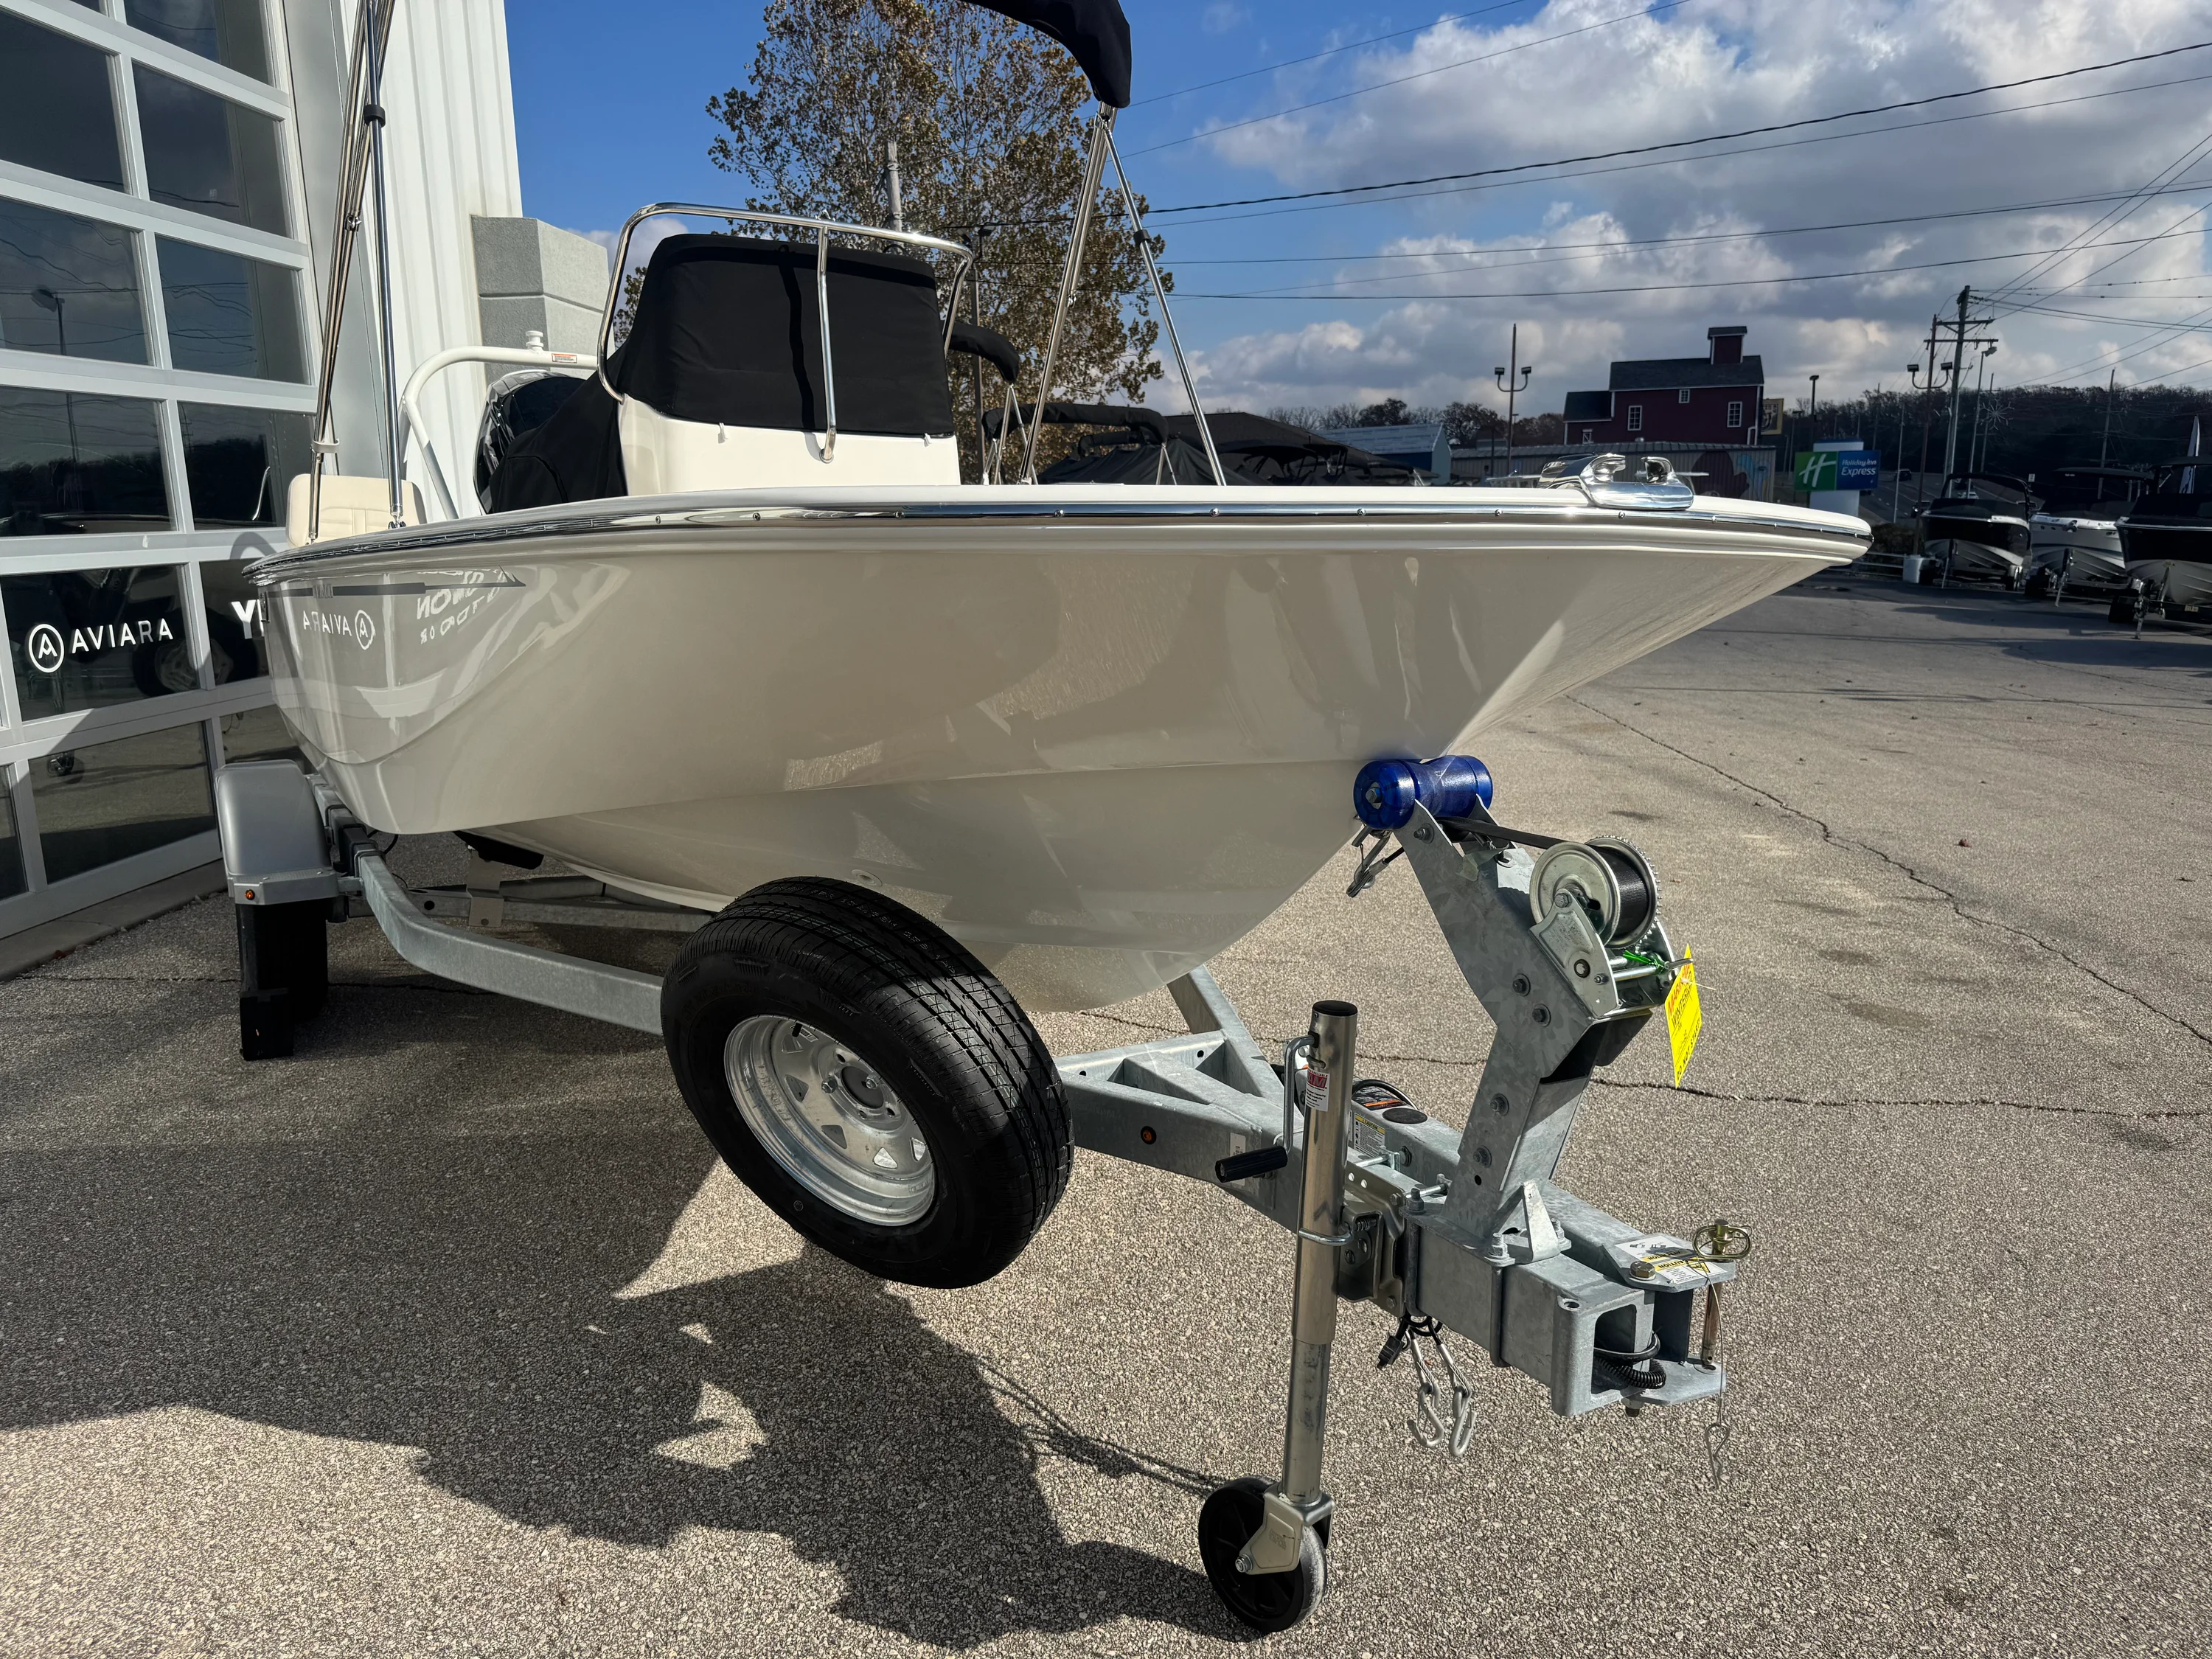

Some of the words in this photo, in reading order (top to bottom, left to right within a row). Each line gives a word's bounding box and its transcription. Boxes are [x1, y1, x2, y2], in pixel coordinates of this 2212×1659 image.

[1842, 459, 1866, 467] Holiday
[1841, 467, 1877, 478] Express
[72, 618, 174, 654] AVIARA
